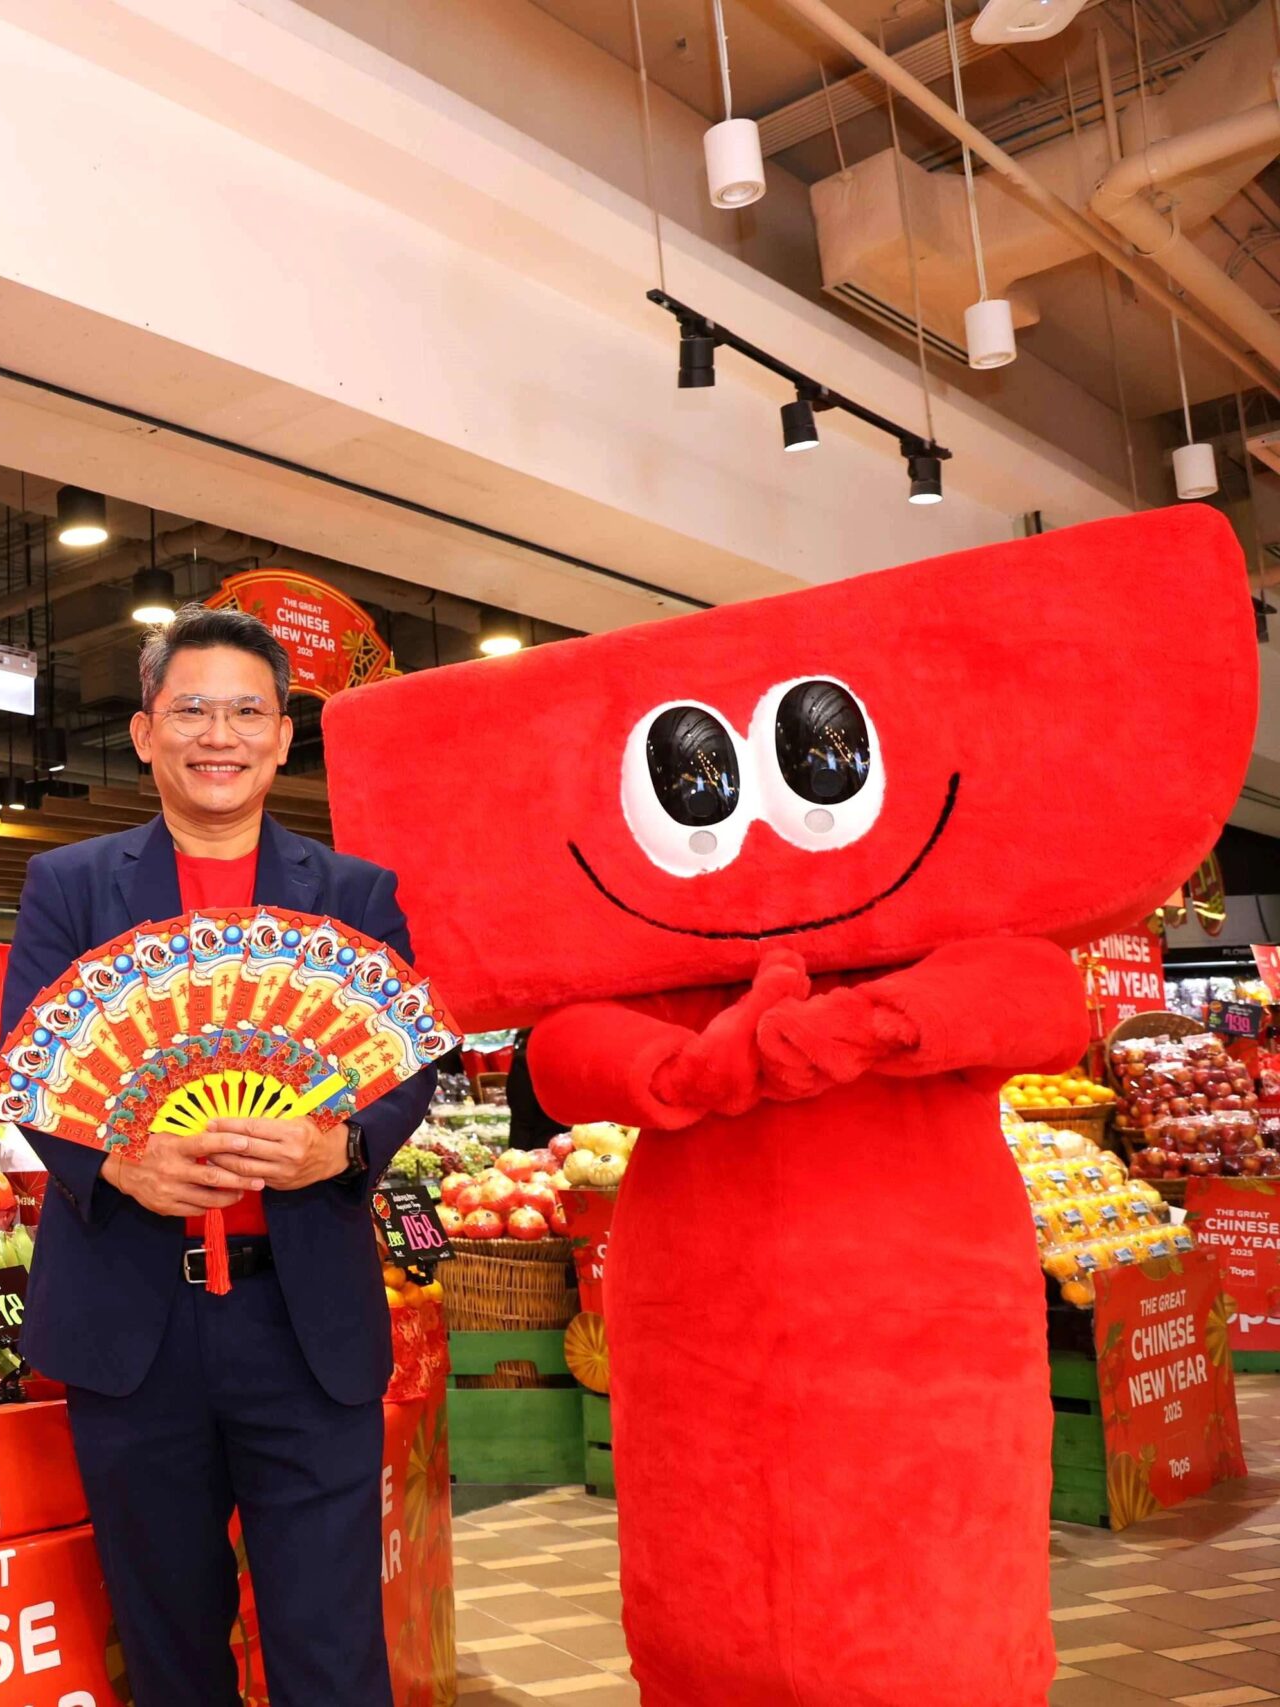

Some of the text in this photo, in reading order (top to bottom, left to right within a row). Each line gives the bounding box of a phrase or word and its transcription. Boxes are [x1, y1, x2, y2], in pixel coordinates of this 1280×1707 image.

[283, 597, 323, 614] THE GREAT
[276, 608, 330, 633] CHINESE
[272, 624, 336, 652] NEW YEAR
[296, 646, 314, 657] 2025
[297, 668, 315, 681] Tops
[1123, 972, 1161, 999] YEAR
[1216, 1209, 1270, 1219] THE GREAT
[1205, 1218, 1280, 1234] CHINESE
[1198, 1233, 1237, 1246] NEW
[1230, 1249, 1254, 1257] 2025
[1229, 1266, 1256, 1278] Tops
[1140, 1289, 1187, 1317] THE GREAT
[1131, 1314, 1196, 1361] CHINESE
[1128, 1354, 1208, 1408] NEW YEAR
[1163, 1401, 1183, 1424] 2025
[1169, 1455, 1190, 1480] Tops
